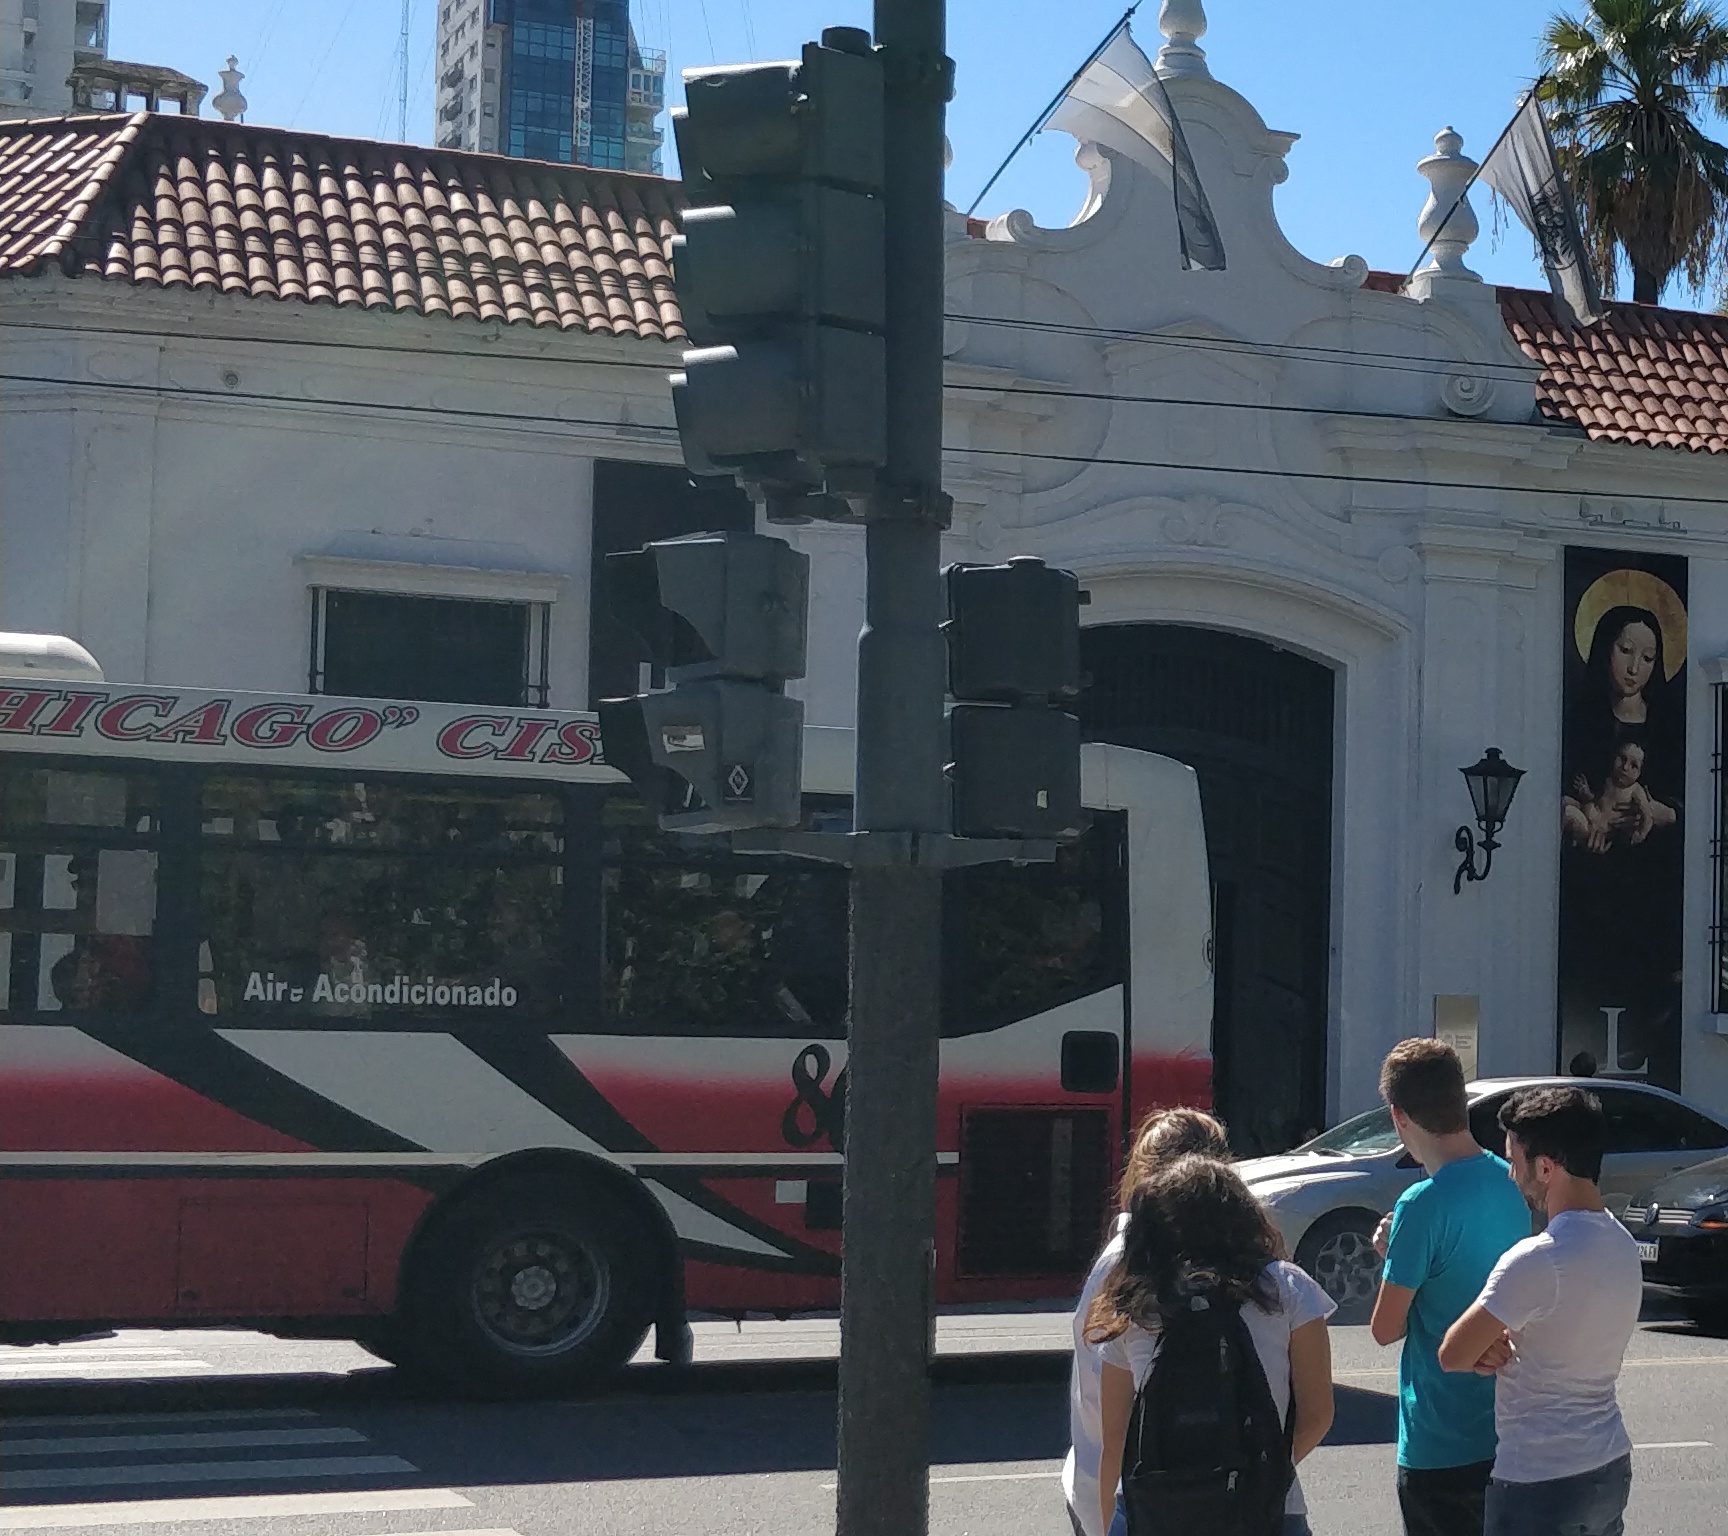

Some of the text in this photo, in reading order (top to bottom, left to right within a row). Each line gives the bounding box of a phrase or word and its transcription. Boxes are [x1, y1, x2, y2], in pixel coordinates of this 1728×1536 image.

[436, 714, 605, 764] CIS
[311, 973, 517, 1007] Acondicionado
[1599, 1006, 1649, 1075] L
